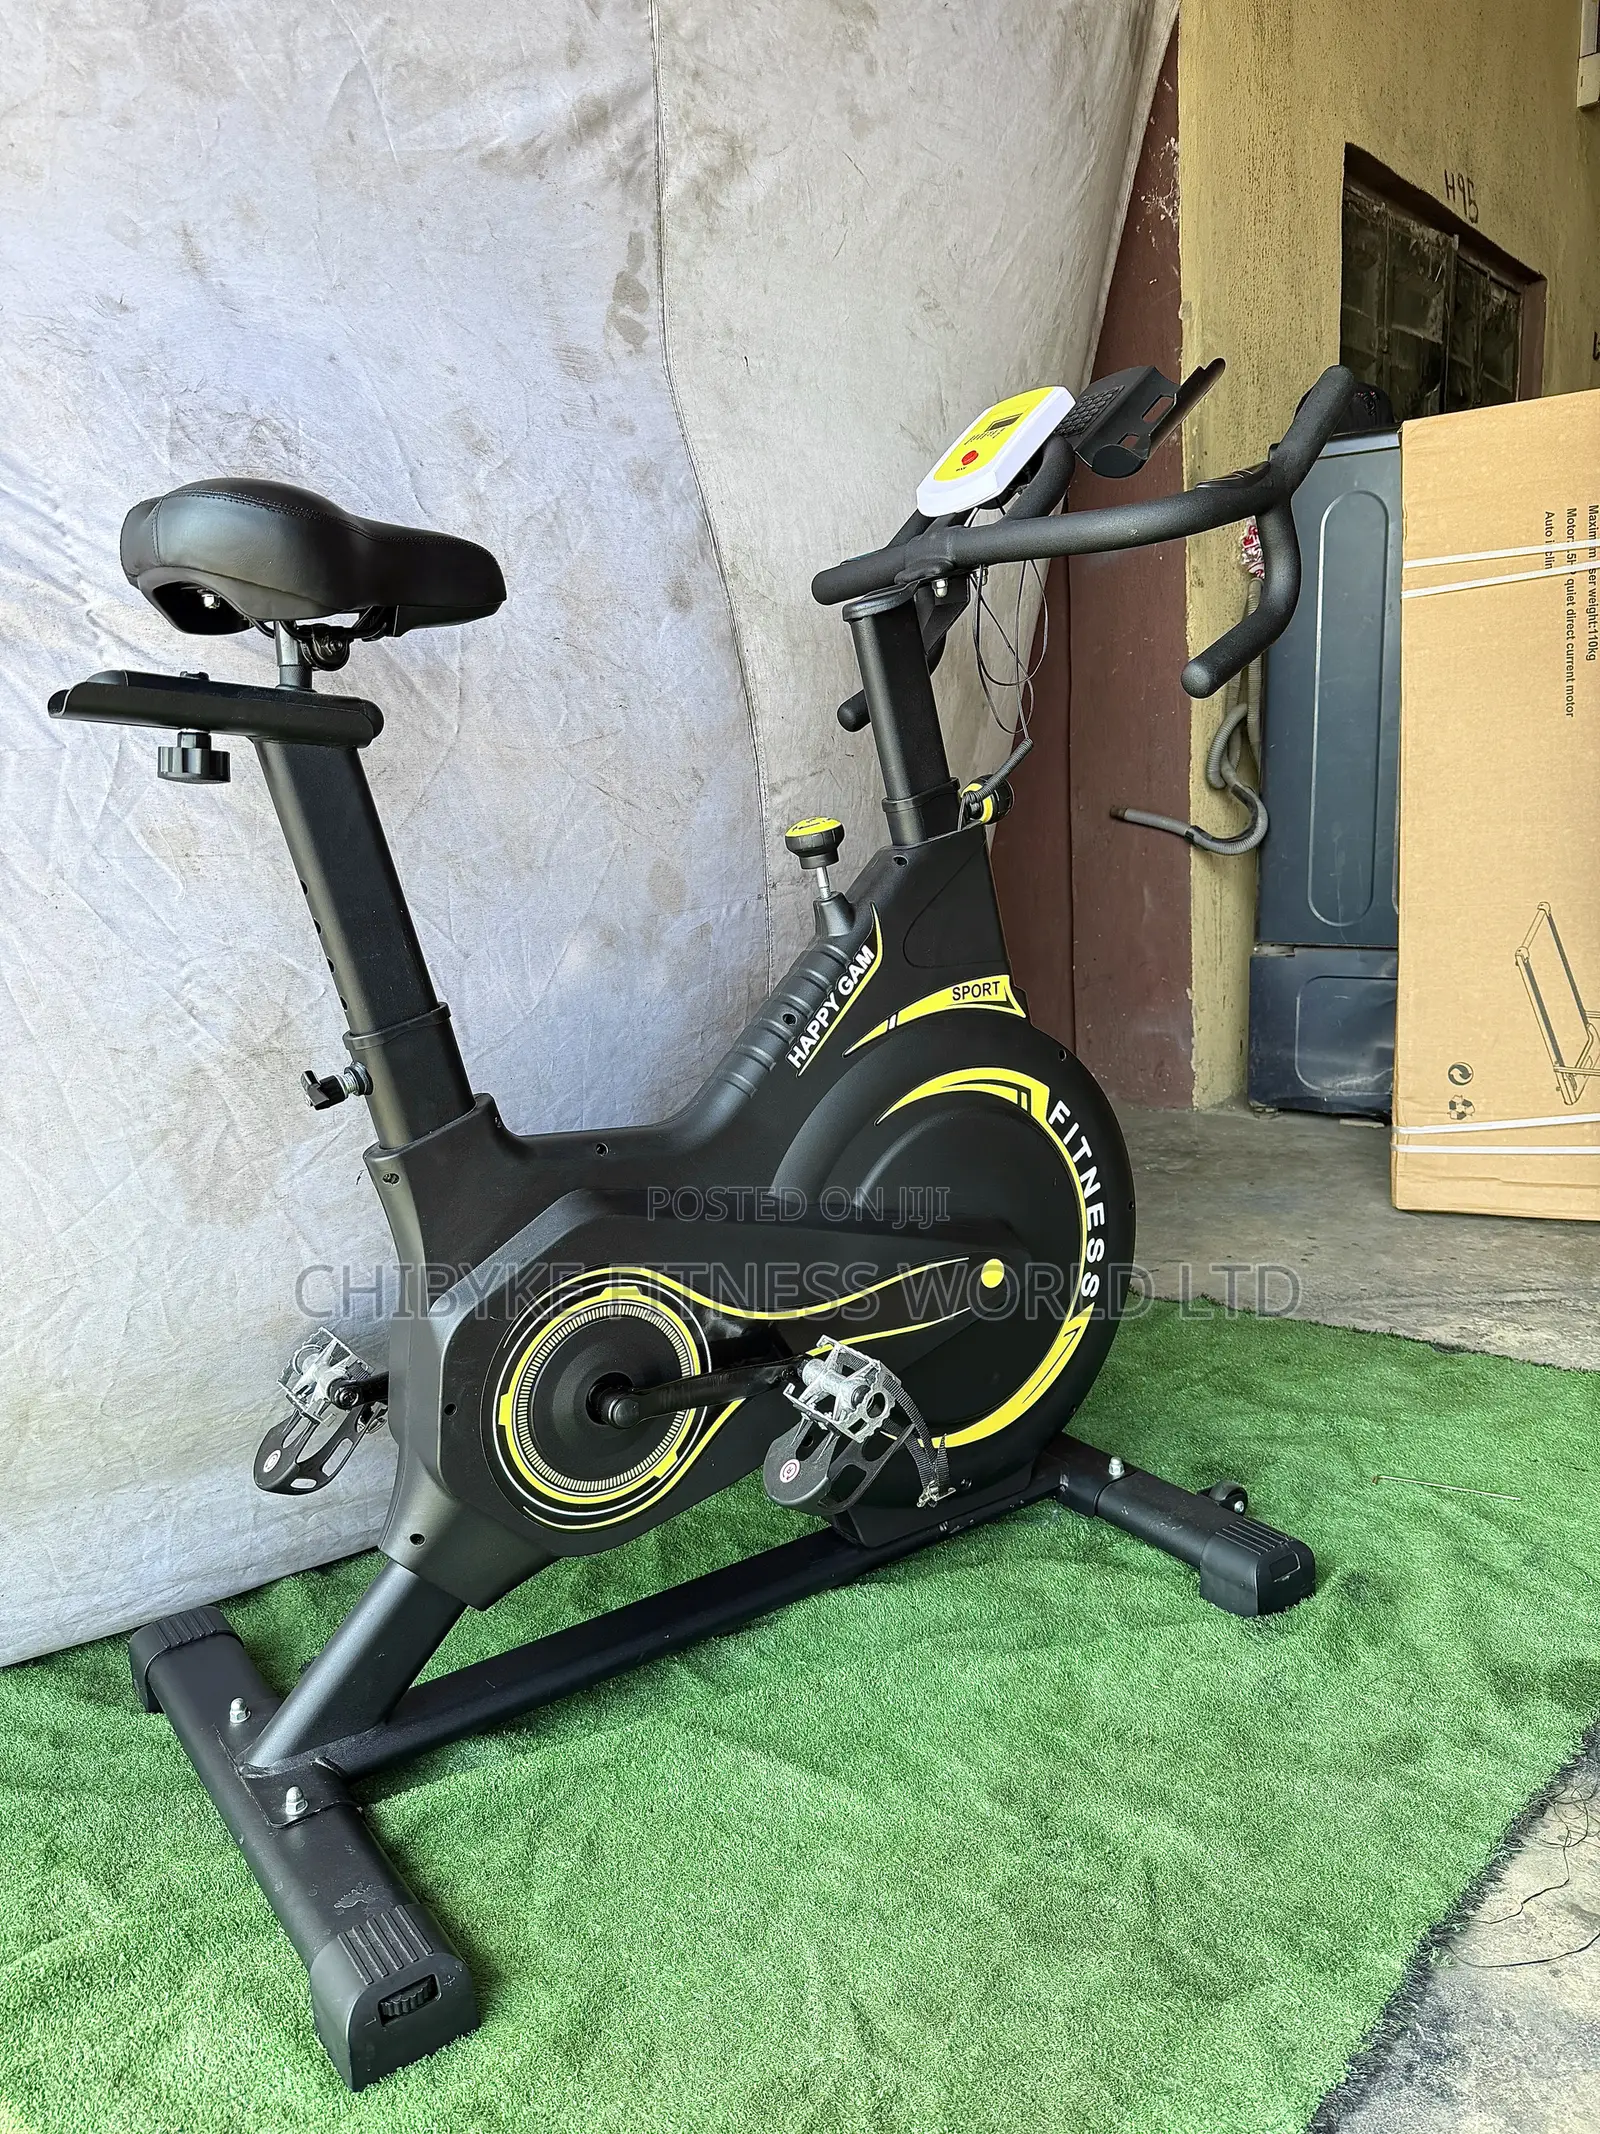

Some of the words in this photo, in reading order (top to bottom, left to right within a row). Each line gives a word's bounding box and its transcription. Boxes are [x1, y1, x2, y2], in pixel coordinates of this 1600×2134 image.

[1545, 511, 1555, 537] Auto
[1587, 505, 1599, 558] Maximm
[1545, 540, 1555, 575] iclin
[1564, 578, 1577, 606] quiet
[1566, 609, 1577, 640] direct
[1585, 588, 1598, 661] weight:110kg
[1565, 643, 1576, 682] current
[1565, 685, 1575, 717] motor
[786, 992, 840, 1069] HAPPY
[837, 944, 875, 996] GAM
[952, 981, 1000, 1001] SPORT
[1048, 1100, 1105, 1298] FITNESS
